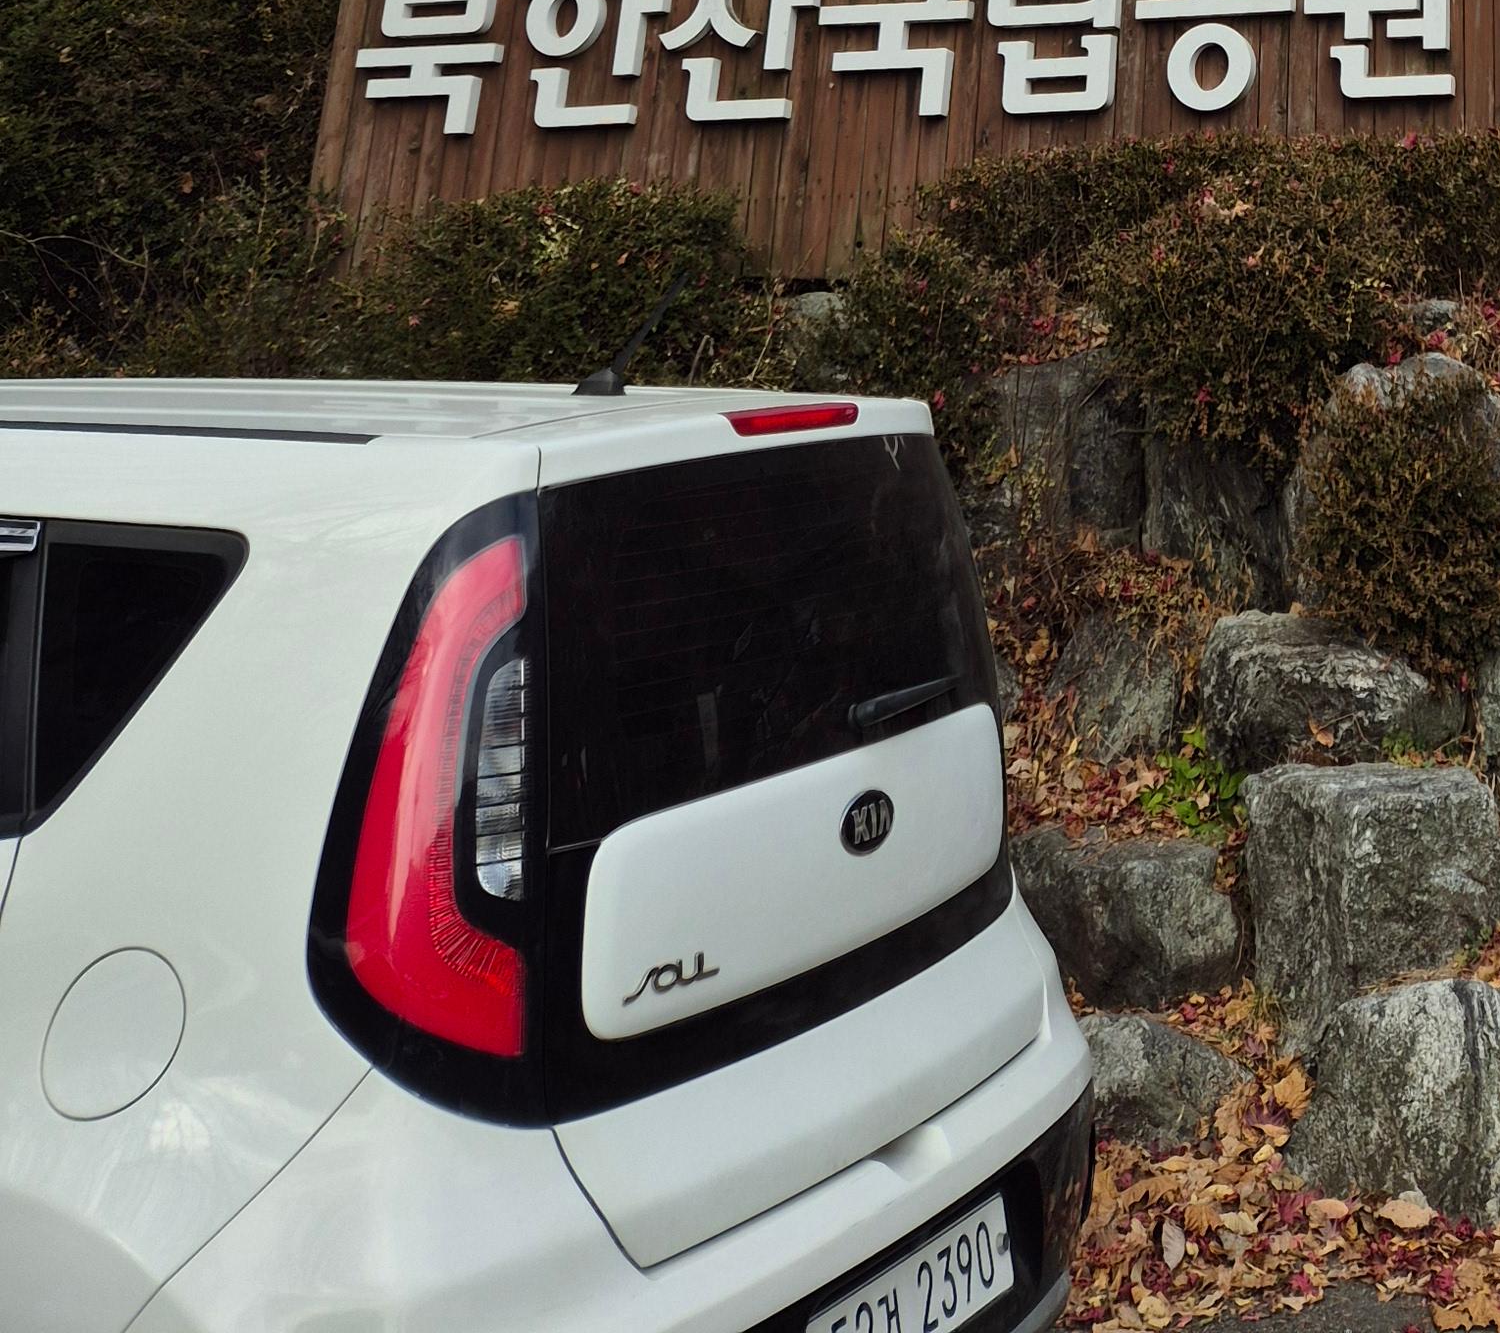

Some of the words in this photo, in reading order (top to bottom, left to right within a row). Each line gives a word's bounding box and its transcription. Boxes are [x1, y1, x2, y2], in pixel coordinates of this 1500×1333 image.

[851, 799, 891, 845] KIA
[622, 951, 721, 1007] SOUL
[917, 1221, 995, 1333] 2390
